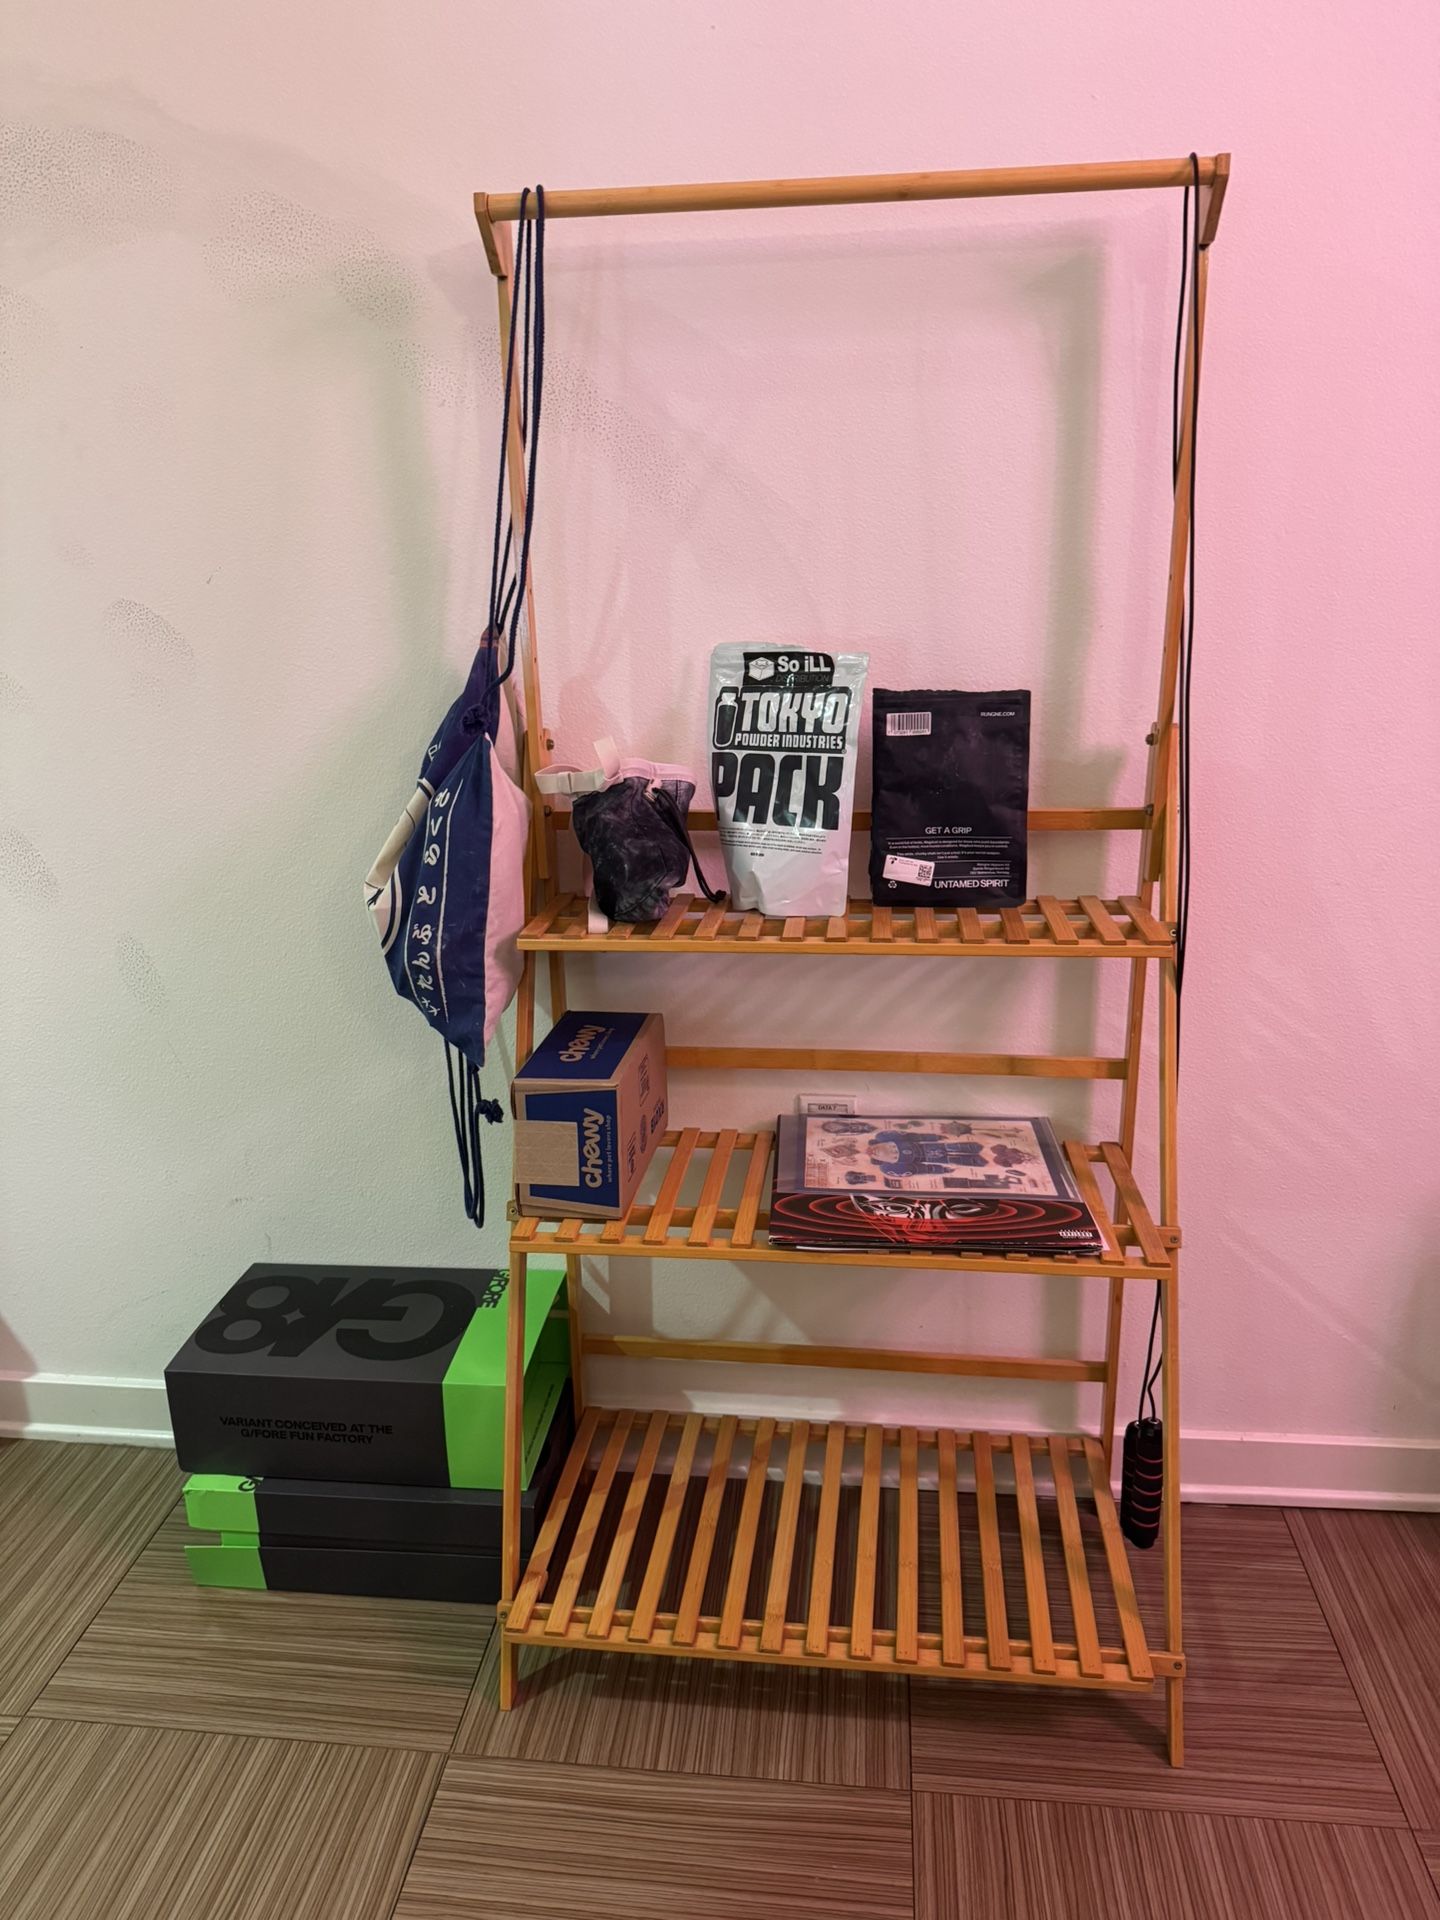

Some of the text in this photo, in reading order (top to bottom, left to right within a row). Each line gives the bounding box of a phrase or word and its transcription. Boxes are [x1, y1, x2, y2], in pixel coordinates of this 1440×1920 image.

[777, 655, 831, 673] So iLL
[774, 673, 831, 683] DIRIBUTION
[740, 691, 849, 734] TOKYO
[734, 732, 844, 750] POWDER INDUSTRIES
[711, 751, 845, 831] PACK
[924, 826, 973, 835] GET A GRIP
[933, 879, 980, 890] UNTAMED
[980, 879, 1010, 889] SPIRIT
[581, 1107, 605, 1188] chewy
[219, 1415, 393, 1435] VARIANT CONCEIVED AT THE
[240, 1428, 374, 1445] G/FORE FUN FACTORY
